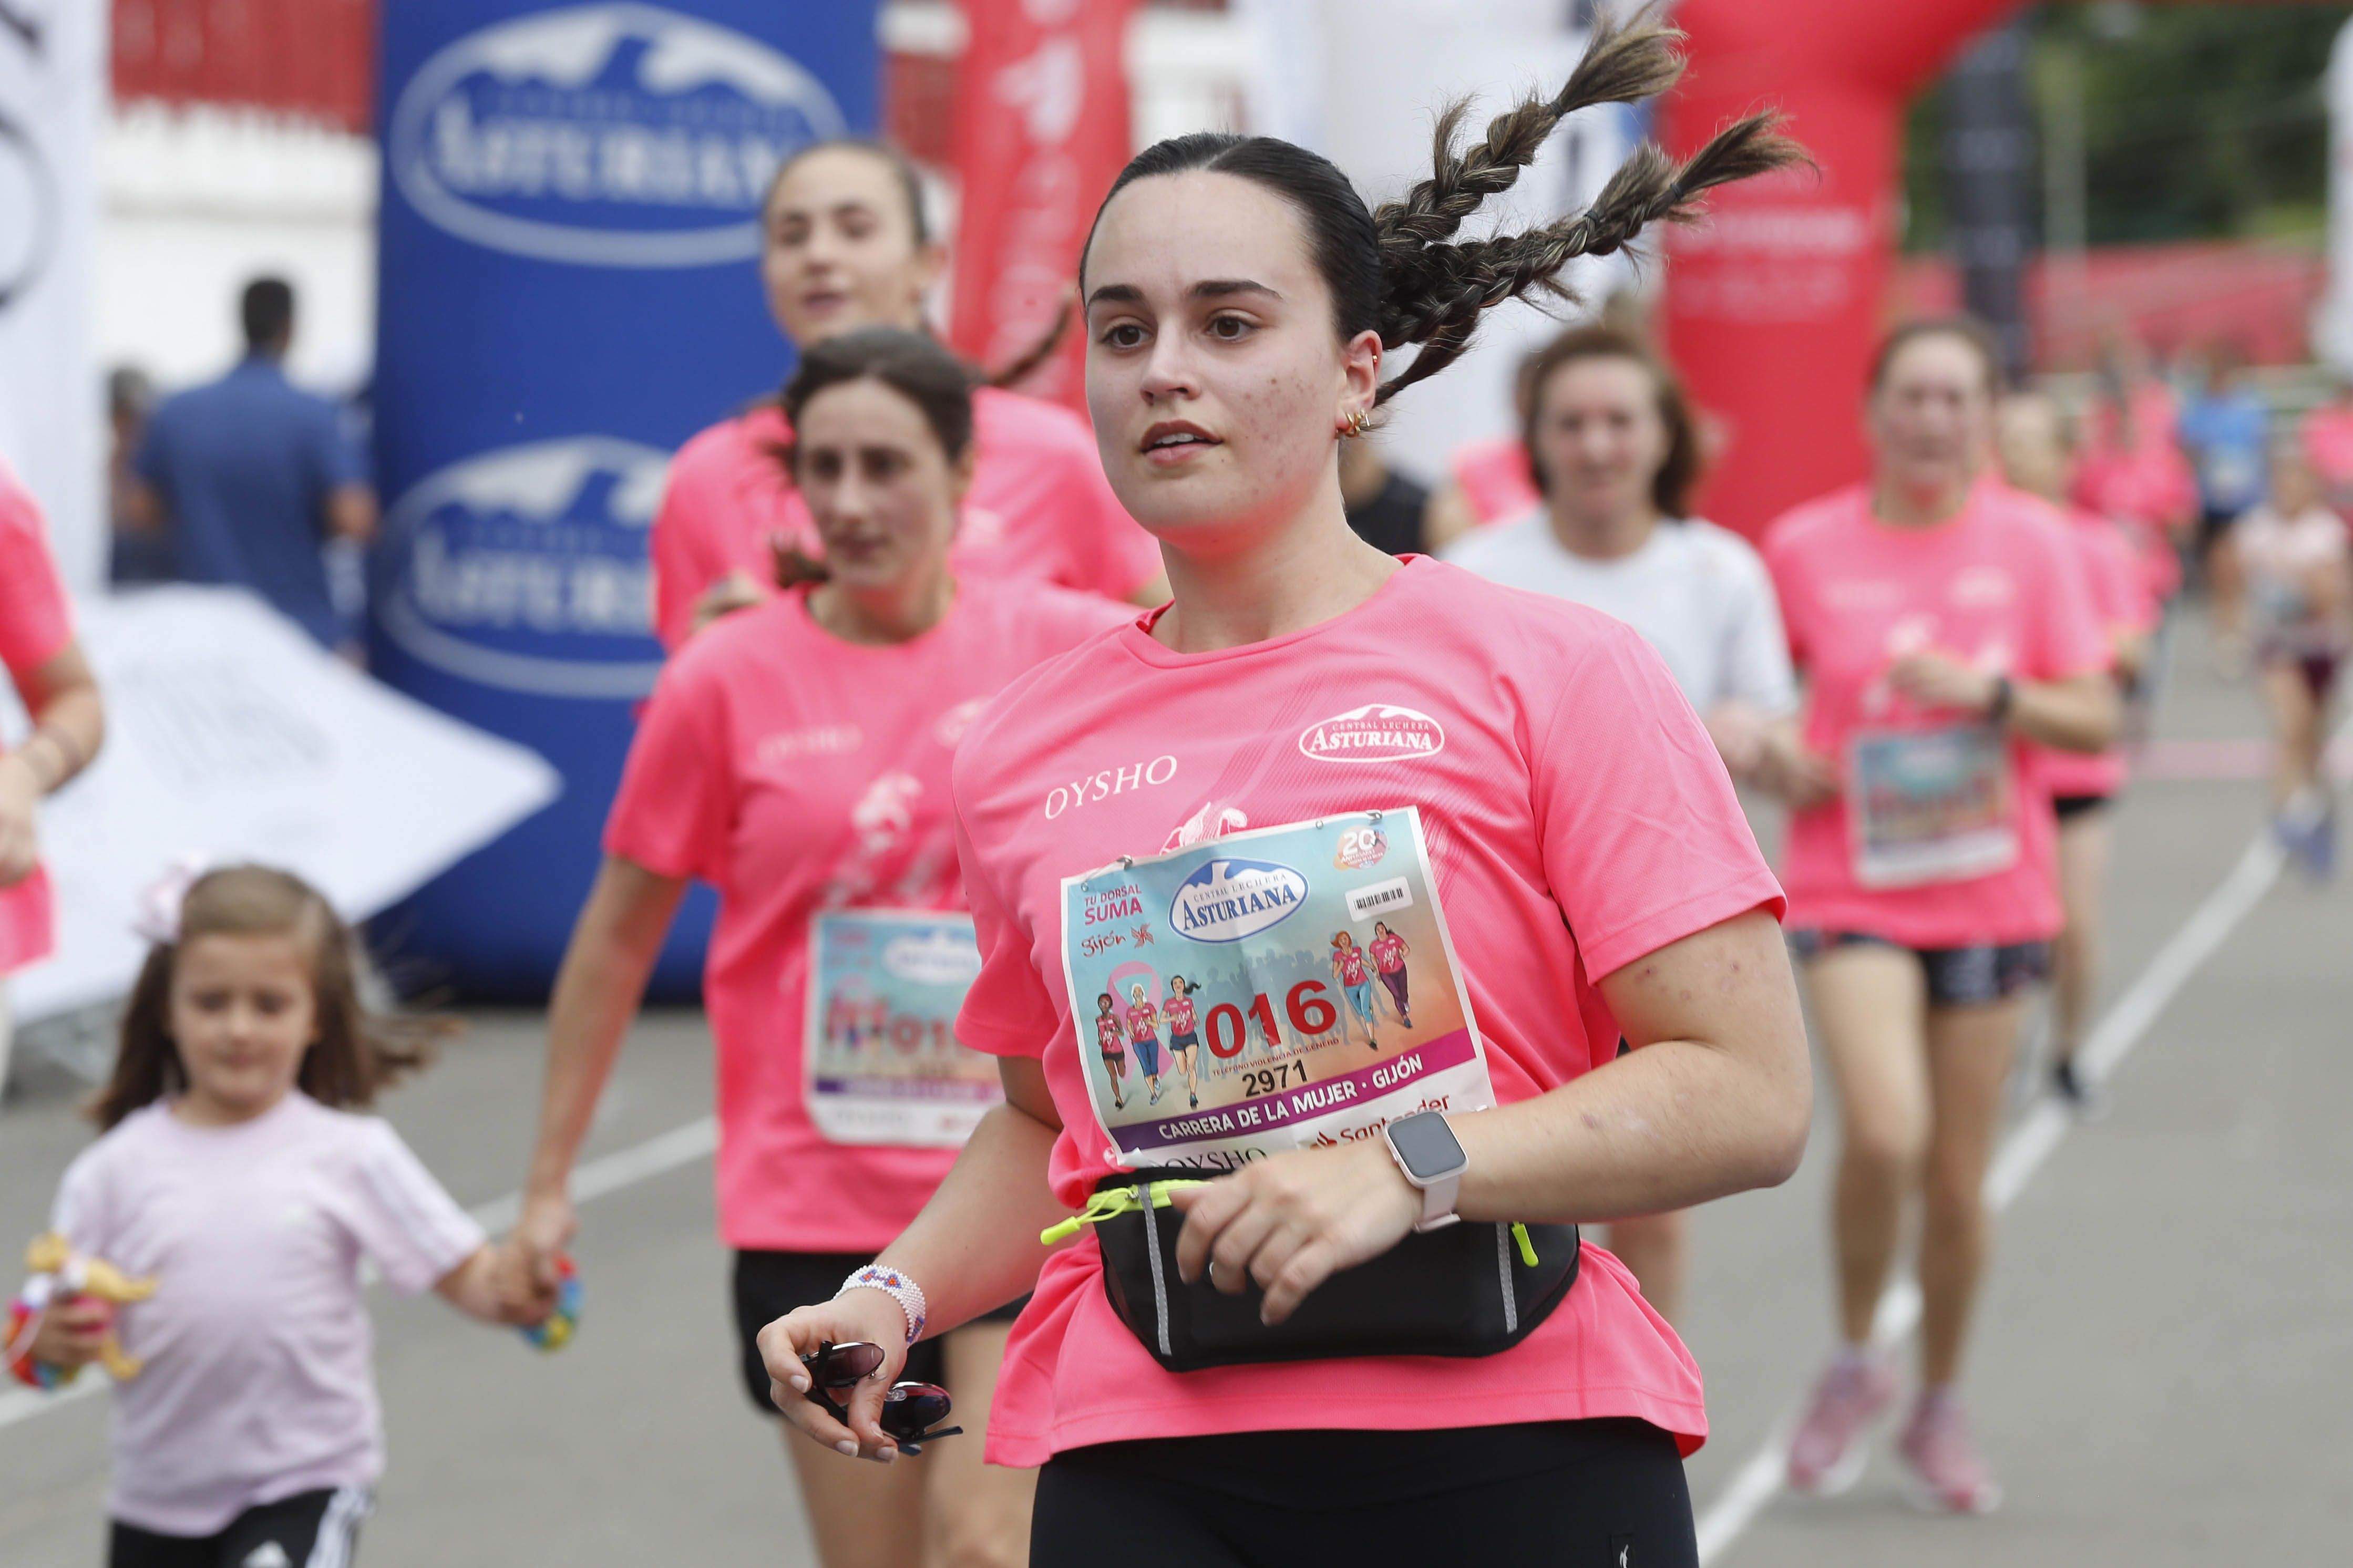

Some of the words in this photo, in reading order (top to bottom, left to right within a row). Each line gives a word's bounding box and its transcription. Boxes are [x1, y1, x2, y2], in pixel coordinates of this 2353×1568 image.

[1309, 727, 1434, 752] ASTURIANA
[1332, 721, 1378, 731] CENTRAL
[1382, 721, 1430, 731] LECHERA
[1045, 755, 1177, 820] OYSHO
[1085, 895, 1097, 907] TU
[1100, 883, 1143, 903] DORSAL
[1193, 887, 1228, 902] CENTRAL
[1232, 873, 1287, 892] LECHERA
[1085, 896, 1143, 925] SUMA
[1183, 884, 1298, 931] ASTURIANA
[1205, 979, 1337, 1059] 016
[1159, 1113, 1236, 1140] CARRERA
[1237, 1106, 1261, 1128] DE
[1264, 1100, 1290, 1122] LA
[1291, 1079, 1358, 1115] MUJER
[1372, 1053, 1424, 1089] GIJÓN
[1241, 1059, 1308, 1098] 2971
[1340, 1094, 1450, 1144] Santder
